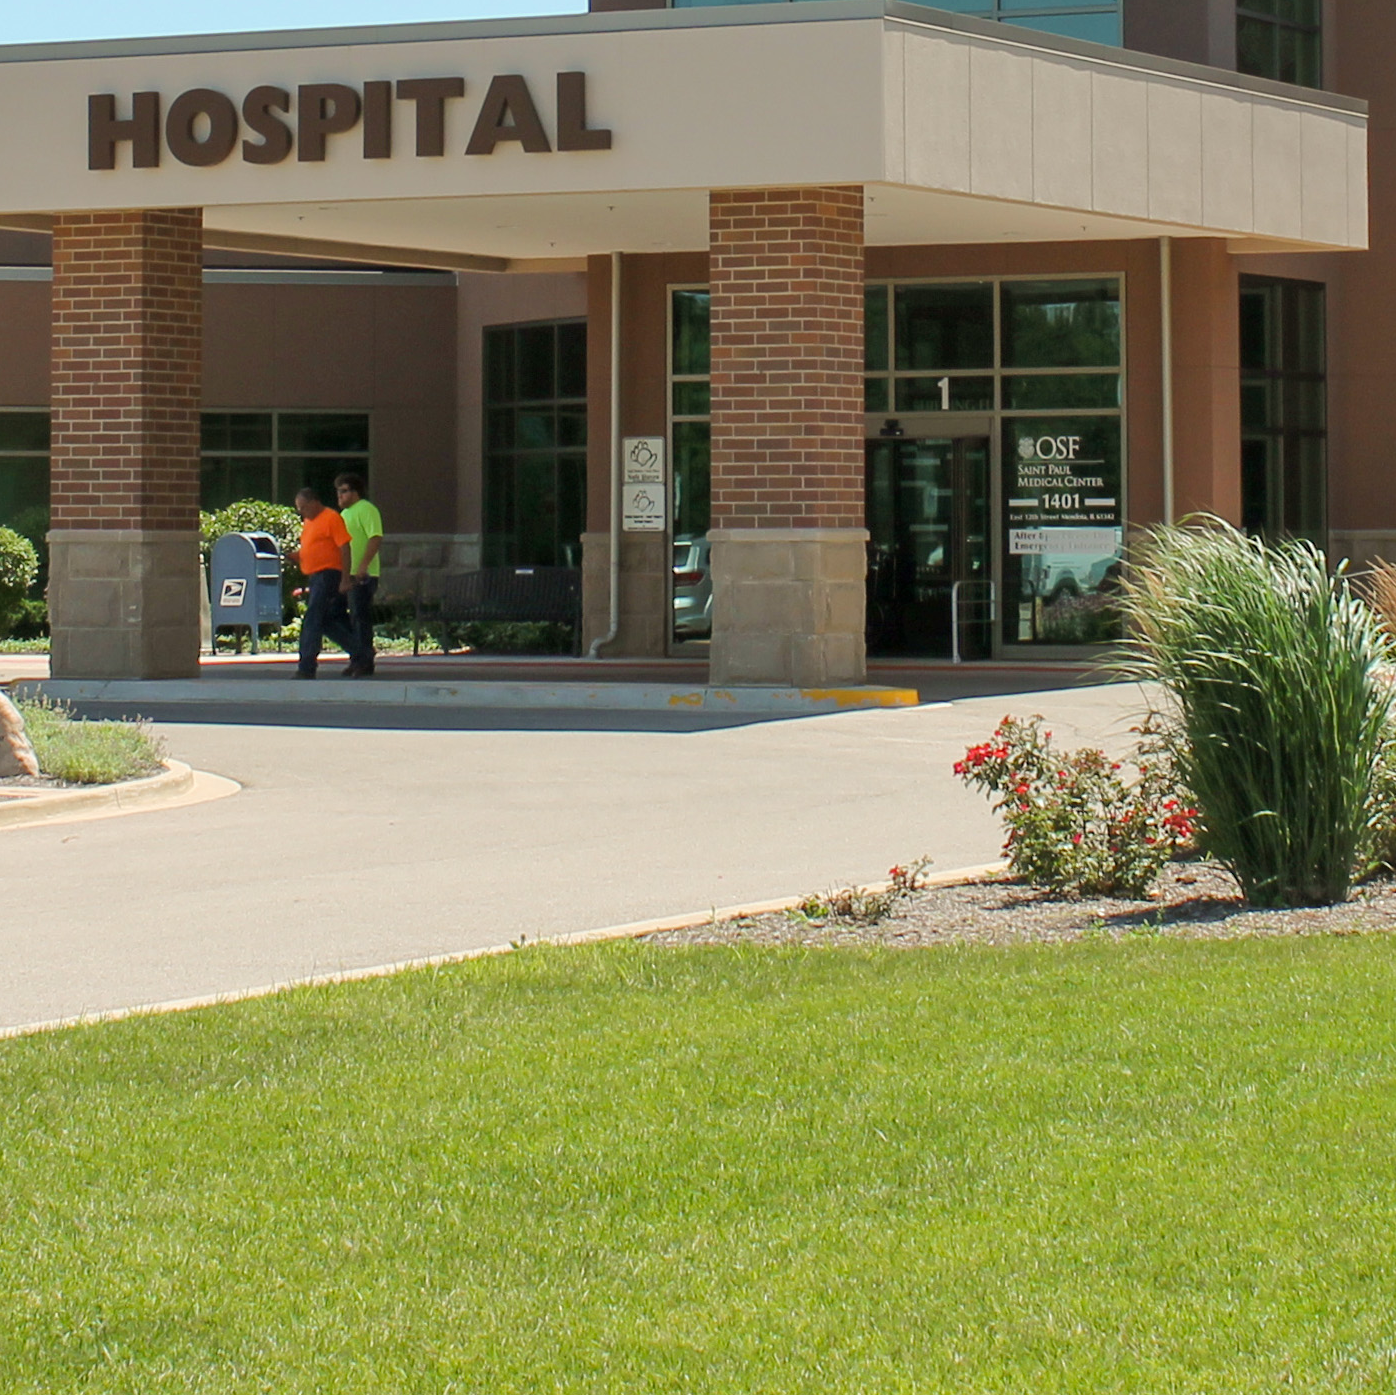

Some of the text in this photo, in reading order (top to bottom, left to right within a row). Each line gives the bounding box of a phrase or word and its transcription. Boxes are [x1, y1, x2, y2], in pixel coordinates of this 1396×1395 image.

[87, 70, 614, 171] HOSPITAL
[937, 377, 949, 410] 1
[1036, 436, 1080, 459] OSF
[1017, 463, 1072, 475] SAINT PAUL
[1017, 476, 1104, 487] MEDICAL CENTER
[1042, 493, 1080, 509] 1401
[1014, 531, 1036, 540] After
